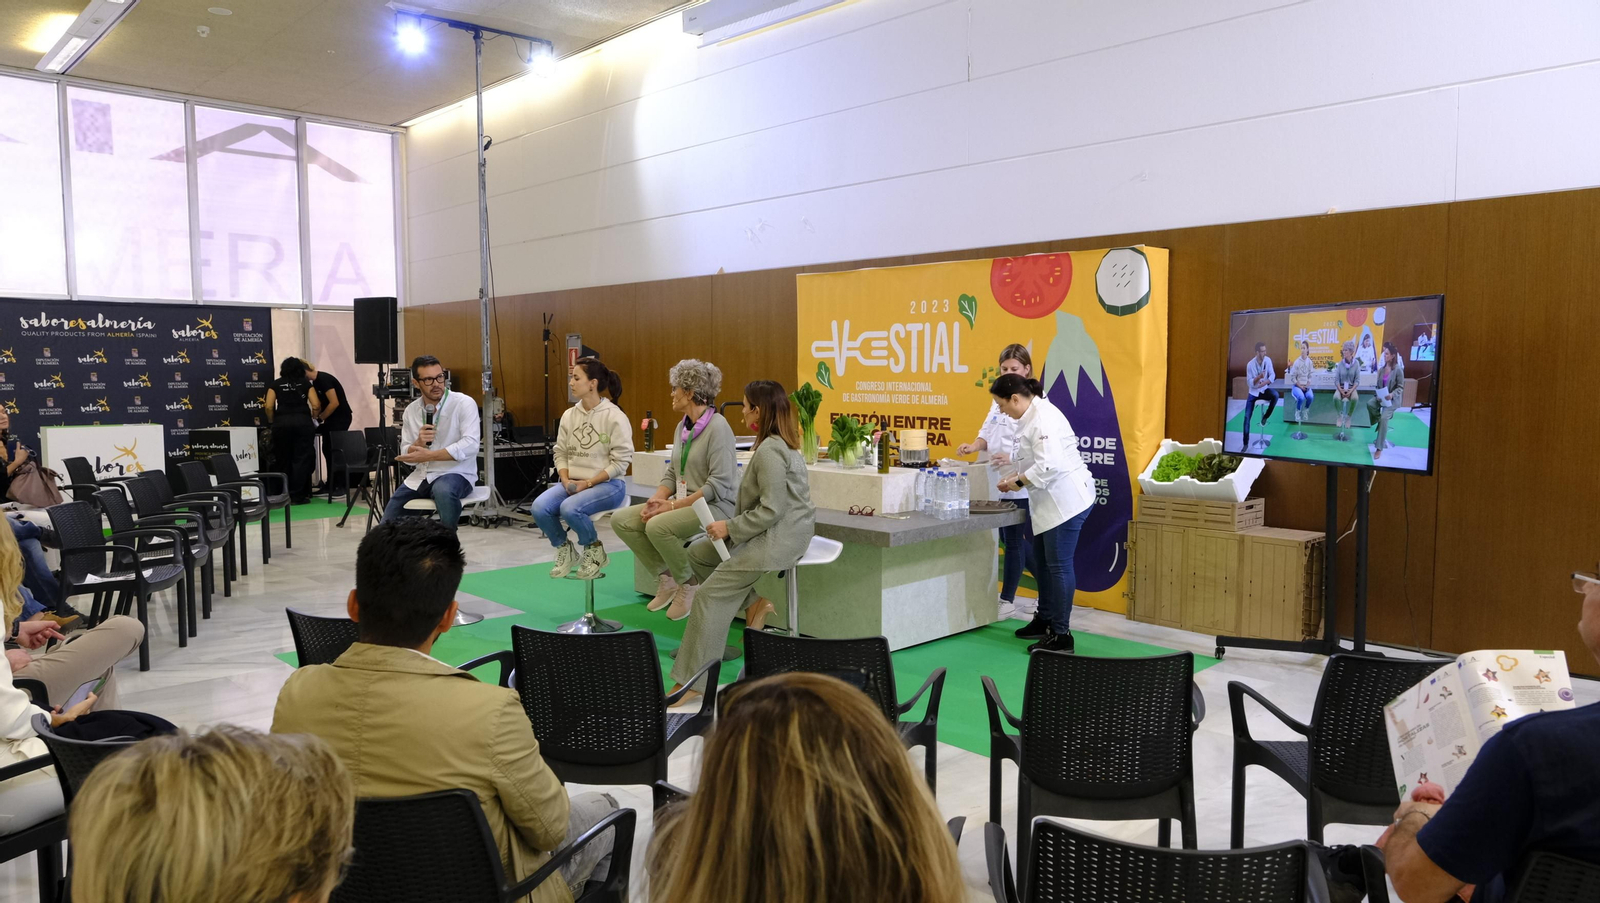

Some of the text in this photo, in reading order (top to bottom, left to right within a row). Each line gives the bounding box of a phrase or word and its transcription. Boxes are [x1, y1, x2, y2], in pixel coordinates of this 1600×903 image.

[910, 299, 949, 314] 2023
[172, 325, 218, 339] sabores
[811, 319, 969, 377] VESTIAL
[856, 381, 933, 392] CONGRESO INTERNACIONAL
[843, 392, 948, 405] DE GASTRONOMÍA VERDE DE ALMERÍA
[894, 415, 951, 430] ENTRE
[1094, 437, 1117, 450] DE
